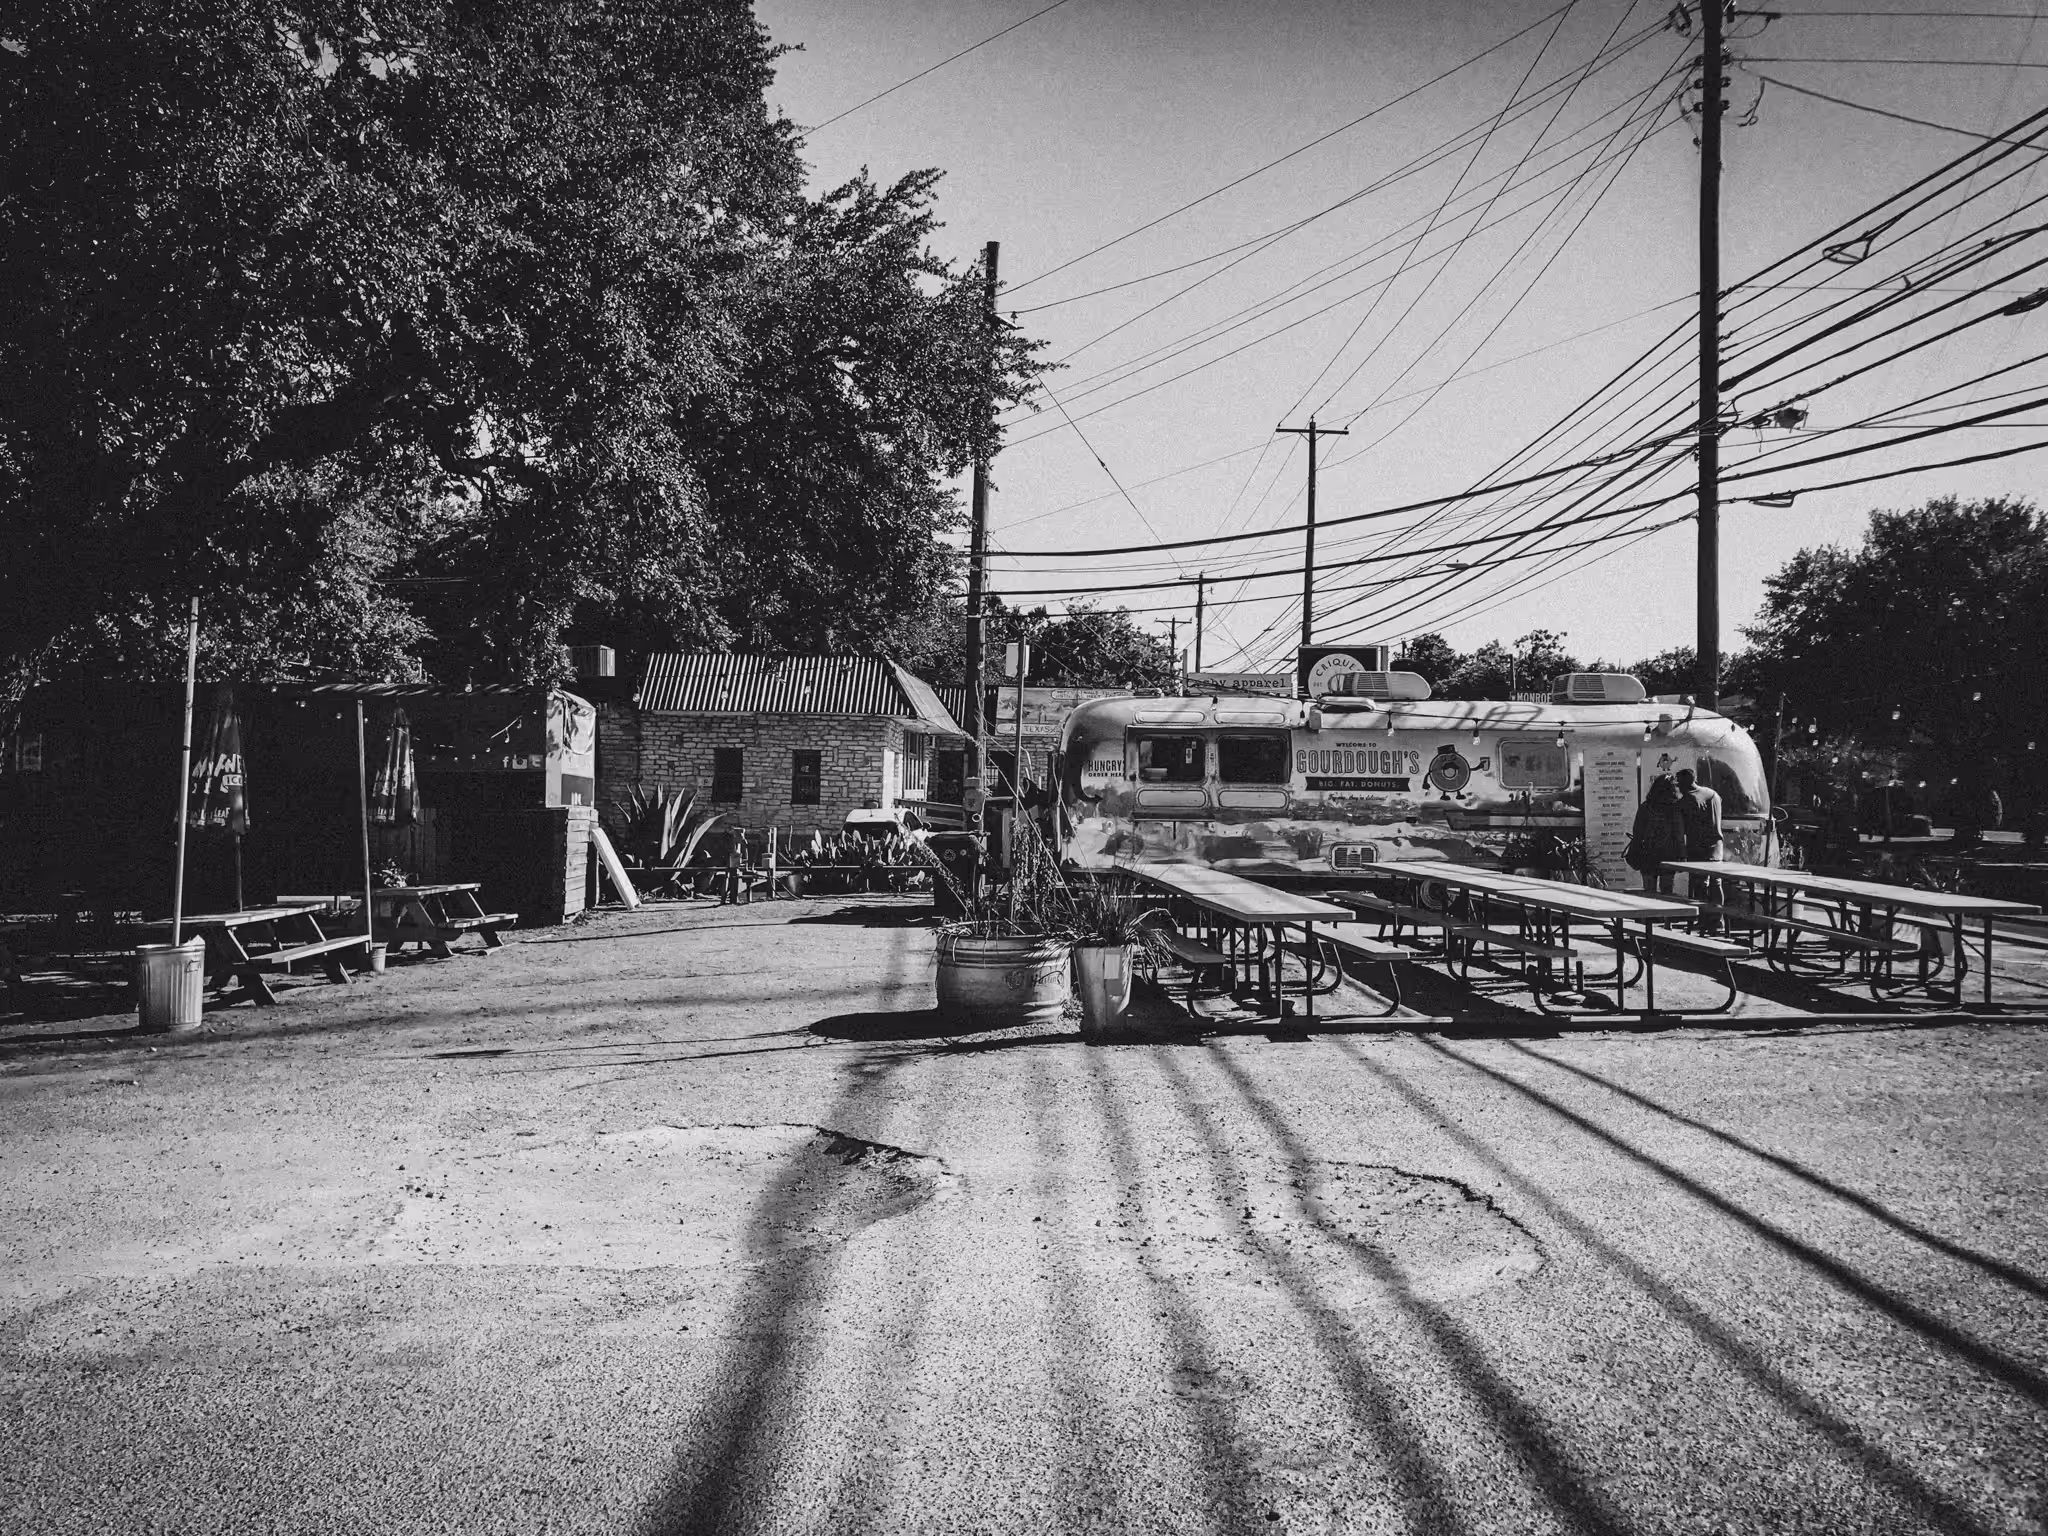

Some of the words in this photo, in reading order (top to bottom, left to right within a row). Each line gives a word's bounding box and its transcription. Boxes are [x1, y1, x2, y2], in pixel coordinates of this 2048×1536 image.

[1315, 658, 1360, 677] CRIQUE
[1232, 678, 1286, 691] apparel
[1516, 692, 1553, 704] MONROE
[1296, 749, 1420, 775] GOURDOUGH'S
